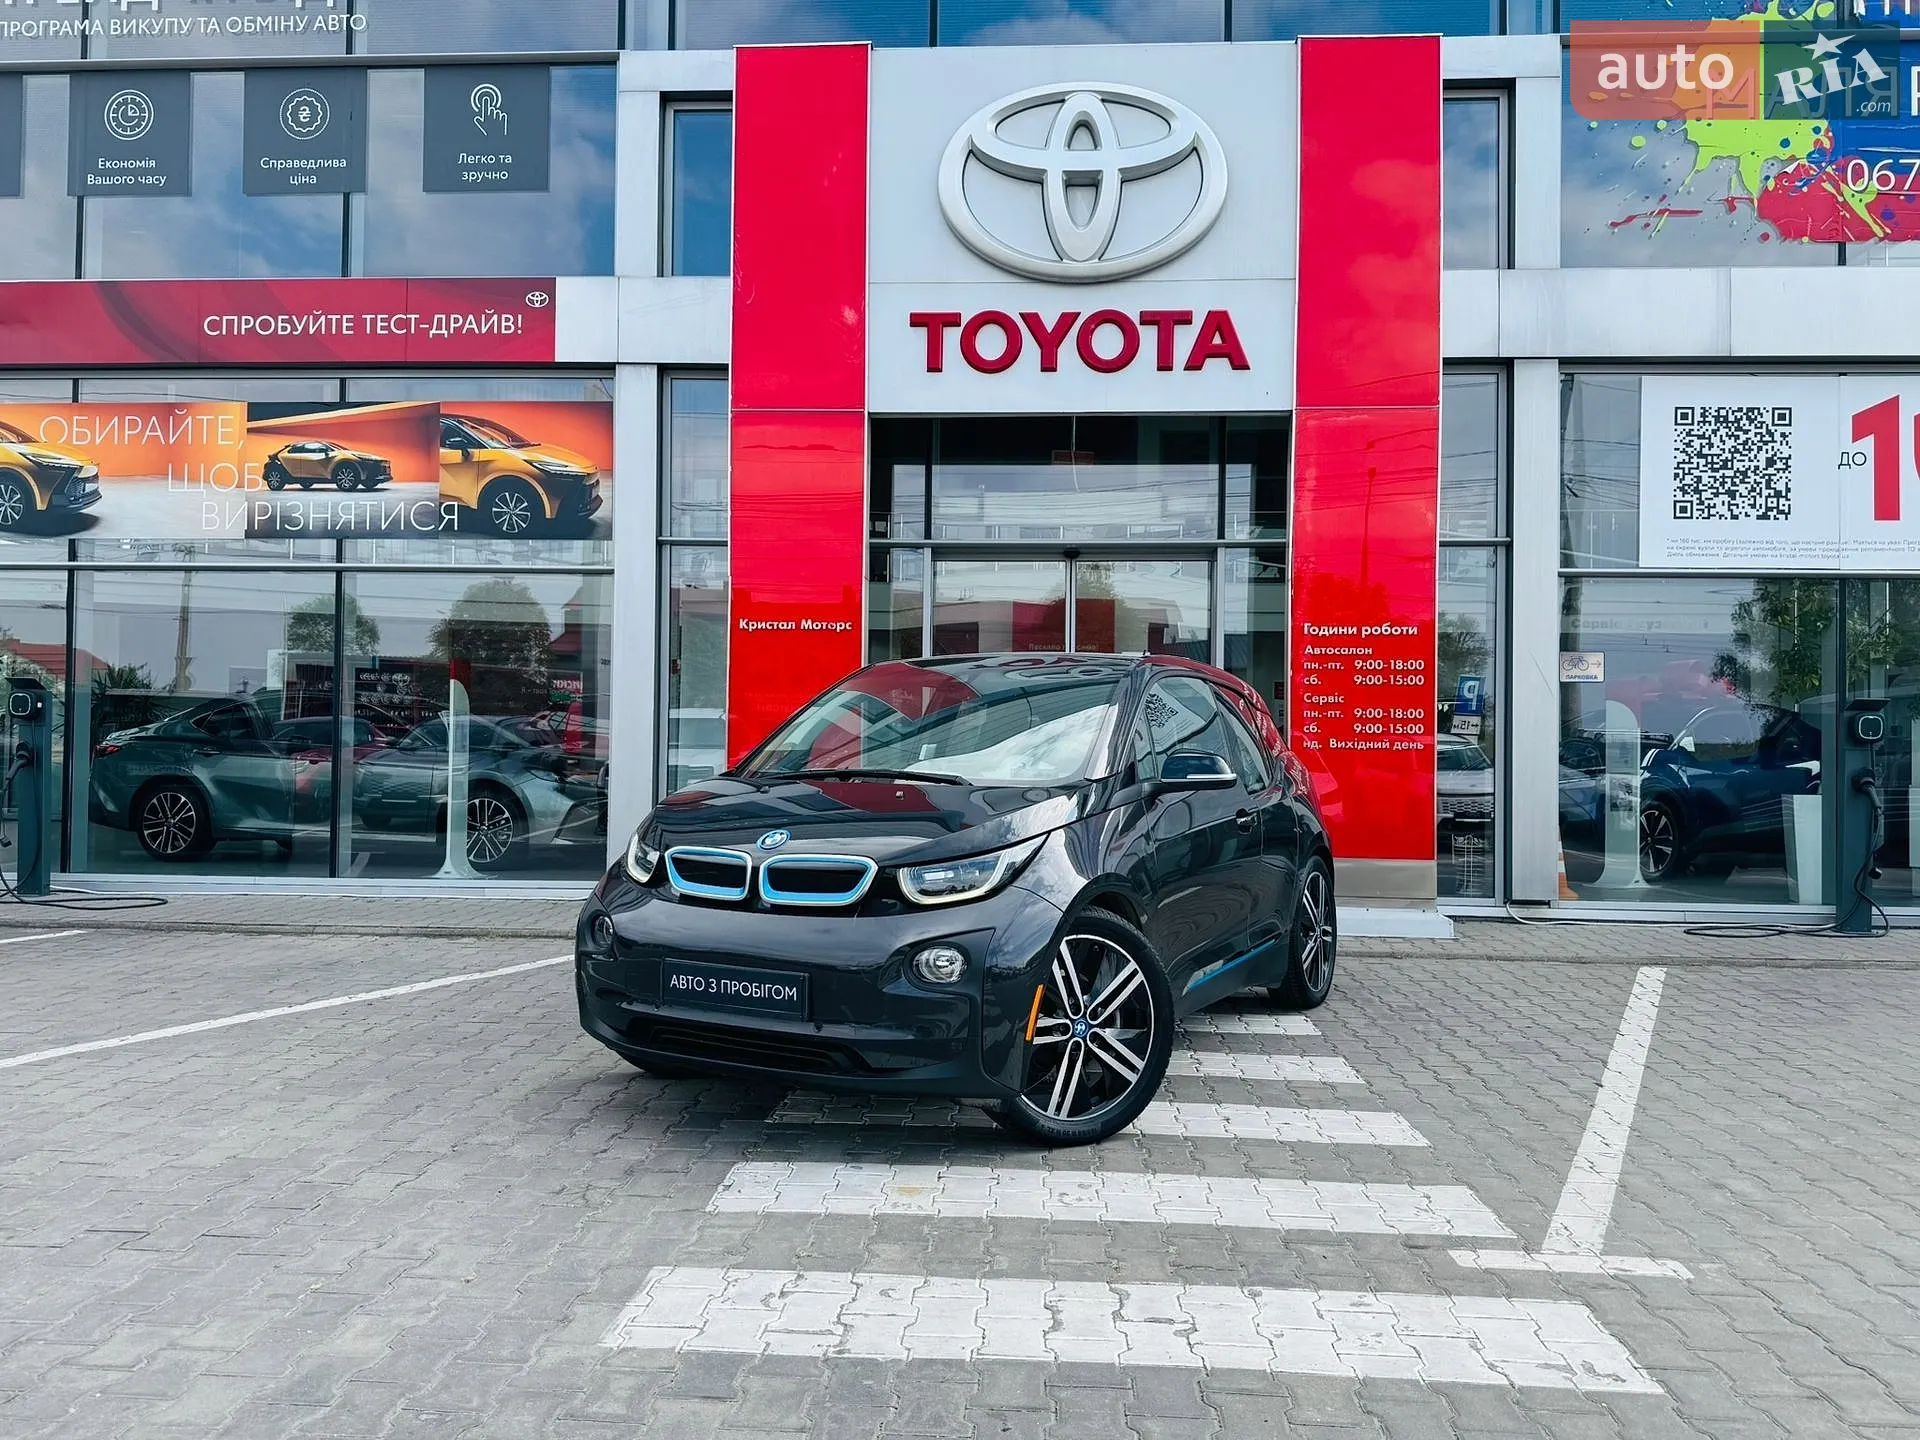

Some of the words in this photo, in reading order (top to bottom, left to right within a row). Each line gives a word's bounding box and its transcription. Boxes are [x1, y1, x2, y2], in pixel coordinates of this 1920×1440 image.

[110, 17, 192, 35] ВИКУПУ
[197, 17, 221, 33] ТА
[226, 15, 309, 33] ОБМІНУ
[313, 14, 367, 31] АВТО
[98, 157, 156, 169] Економія
[260, 156, 347, 170] Справедлива
[457, 152, 496, 165] Легко
[498, 154, 512, 164] та
[87, 173, 135, 185] Вашого
[137, 175, 167, 187] часу
[289, 173, 317, 185] ціна
[461, 169, 509, 182] зручно
[1846, 159, 1920, 191] 067
[203, 310, 355, 336] СПРОБУЙТЕ
[362, 309, 523, 338] ТЕСТ-ДРАЙВ!
[909, 309, 1251, 374] TOYOTA
[39, 408, 245, 450] ОБИРАЙТЕ,
[1851, 394, 1920, 521] 1
[167, 463, 265, 494] ЩОБ
[202, 500, 459, 532] ВИРІЗНЯТИСЯ
[739, 618, 796, 632] Кристал
[800, 618, 853, 632] Моторс
[1303, 622, 1357, 636] Години
[1361, 621, 1418, 638] роботи
[1304, 644, 1373, 655] Автосалон
[1303, 661, 1345, 670] пн.-пт.
[1354, 659, 1425, 670] 9:00-18:00
[1303, 674, 1322, 685] сб.
[1353, 674, 1425, 685] 9:00-15:00
[1303, 691, 1345, 705] Сервіс
[1303, 709, 1344, 718] пн.-пт.
[1353, 707, 1425, 719] 9:00-18:00
[1303, 721, 1322, 733] сб.
[1353, 723, 1425, 734] 9:00-15:00
[1303, 740, 1322, 750] нд.
[1329, 738, 1390, 750] Вихідний
[1392, 741, 1425, 751] день
[670, 974, 705, 991] АВТО
[720, 979, 797, 1001] ПРОБІГОМ
